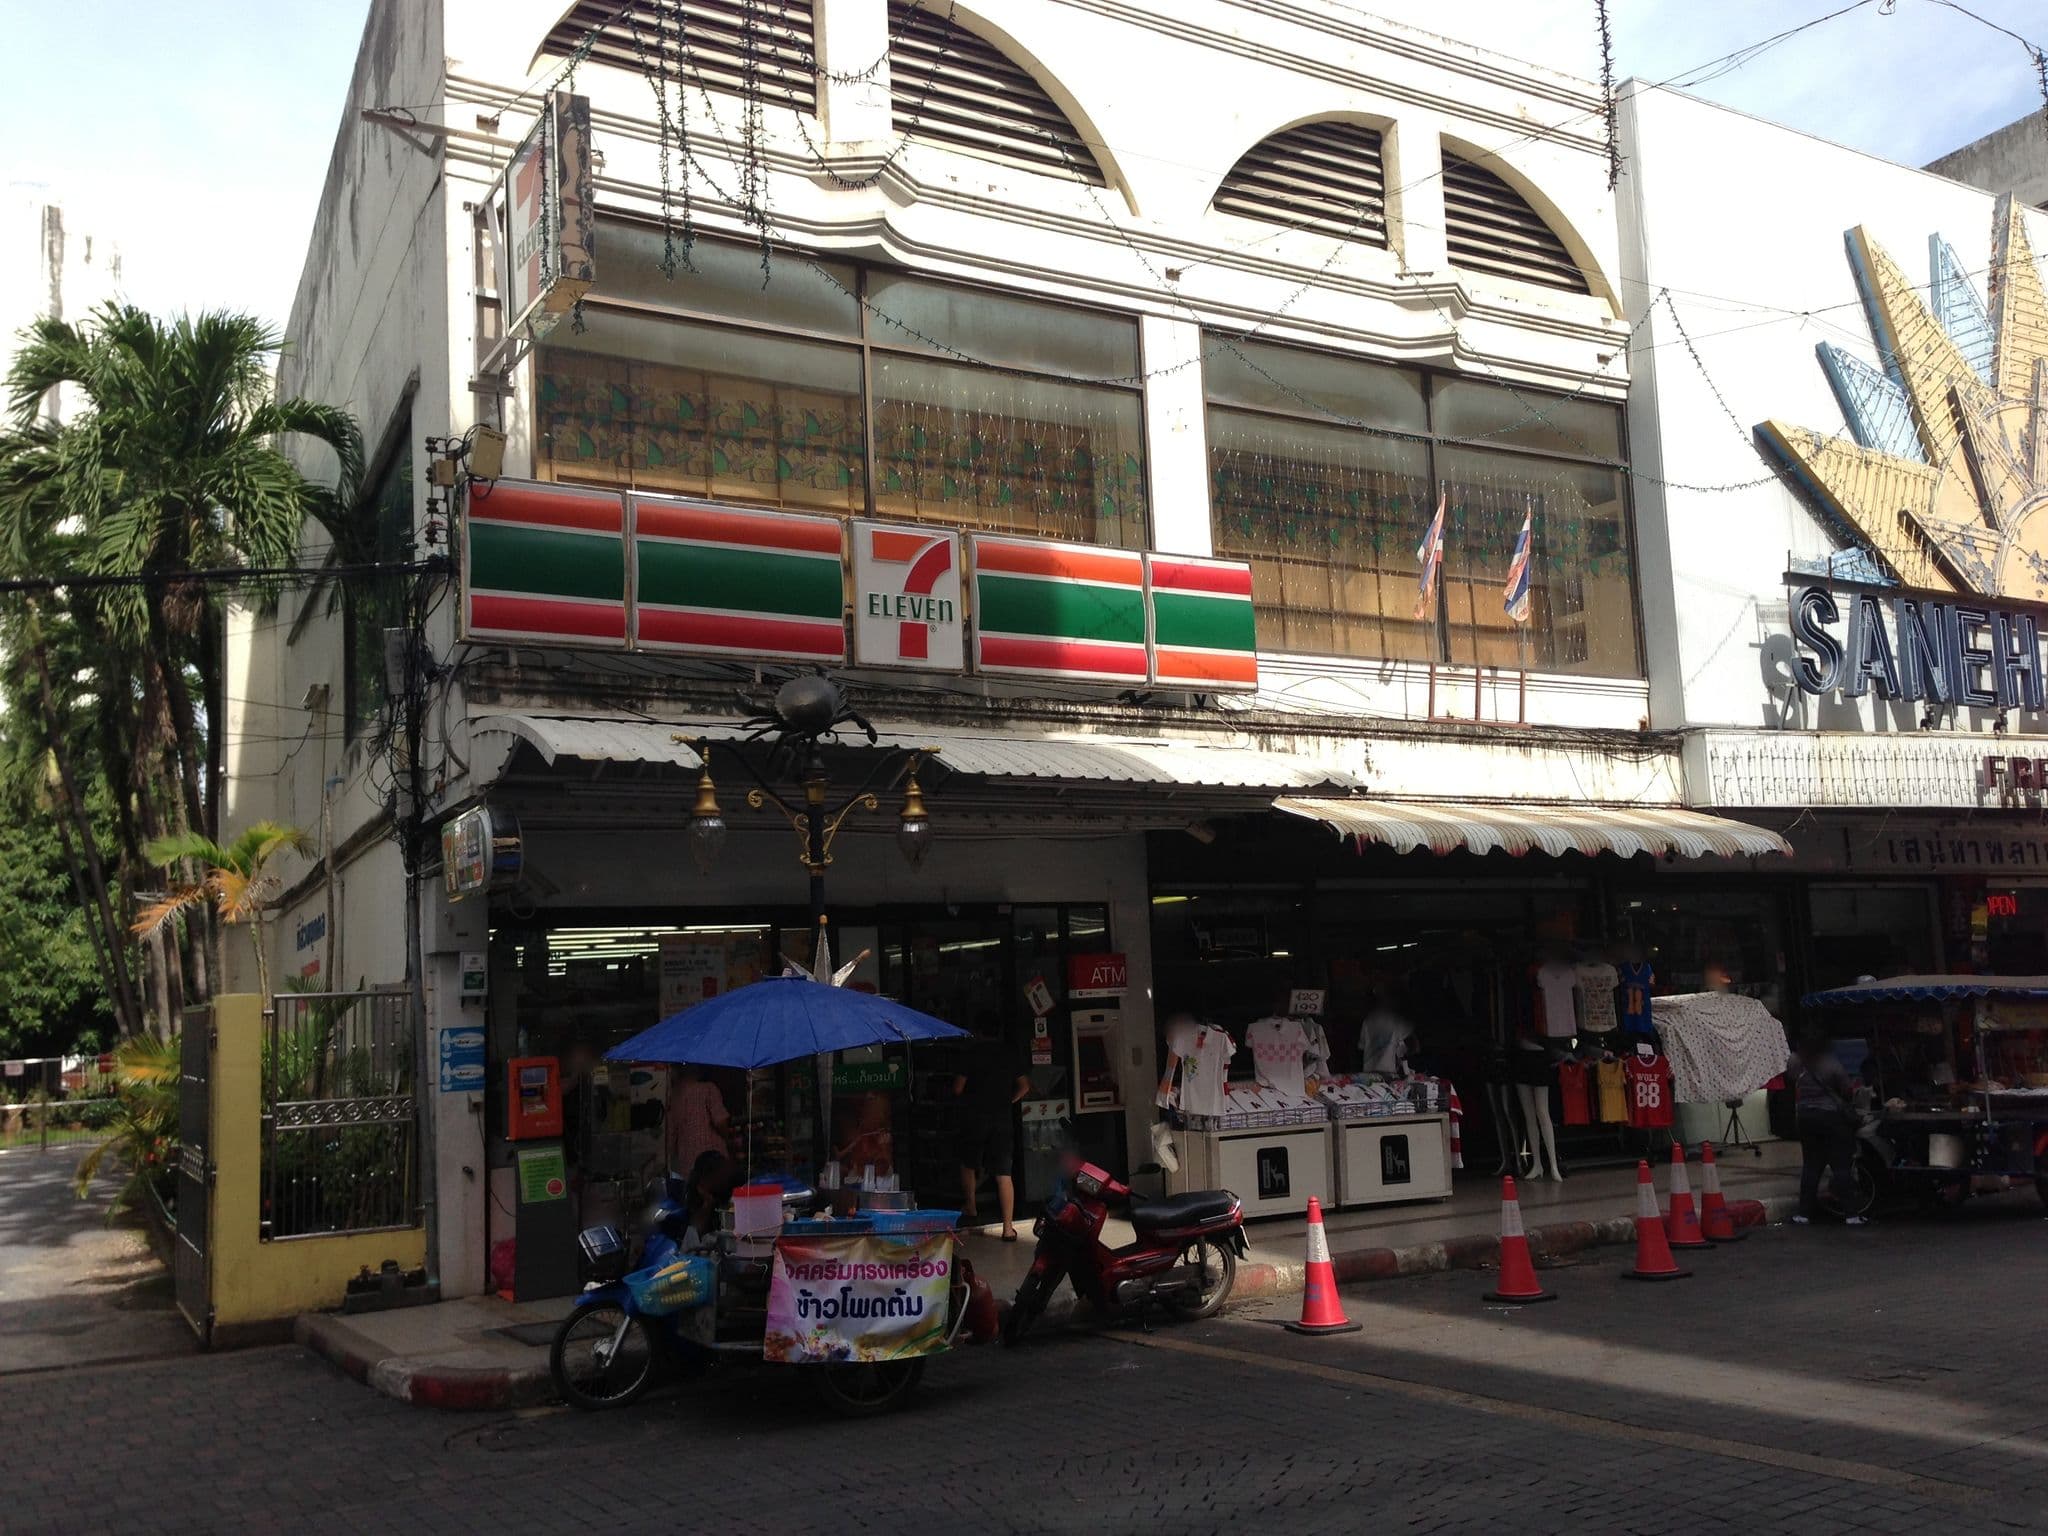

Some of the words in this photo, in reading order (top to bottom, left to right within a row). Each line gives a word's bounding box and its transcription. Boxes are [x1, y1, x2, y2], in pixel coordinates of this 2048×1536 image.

[1091, 966, 1127, 984] ATM
[1636, 1082, 1660, 1108] 88
[797, 1286, 923, 1319] ข้าวโพดต้ม
